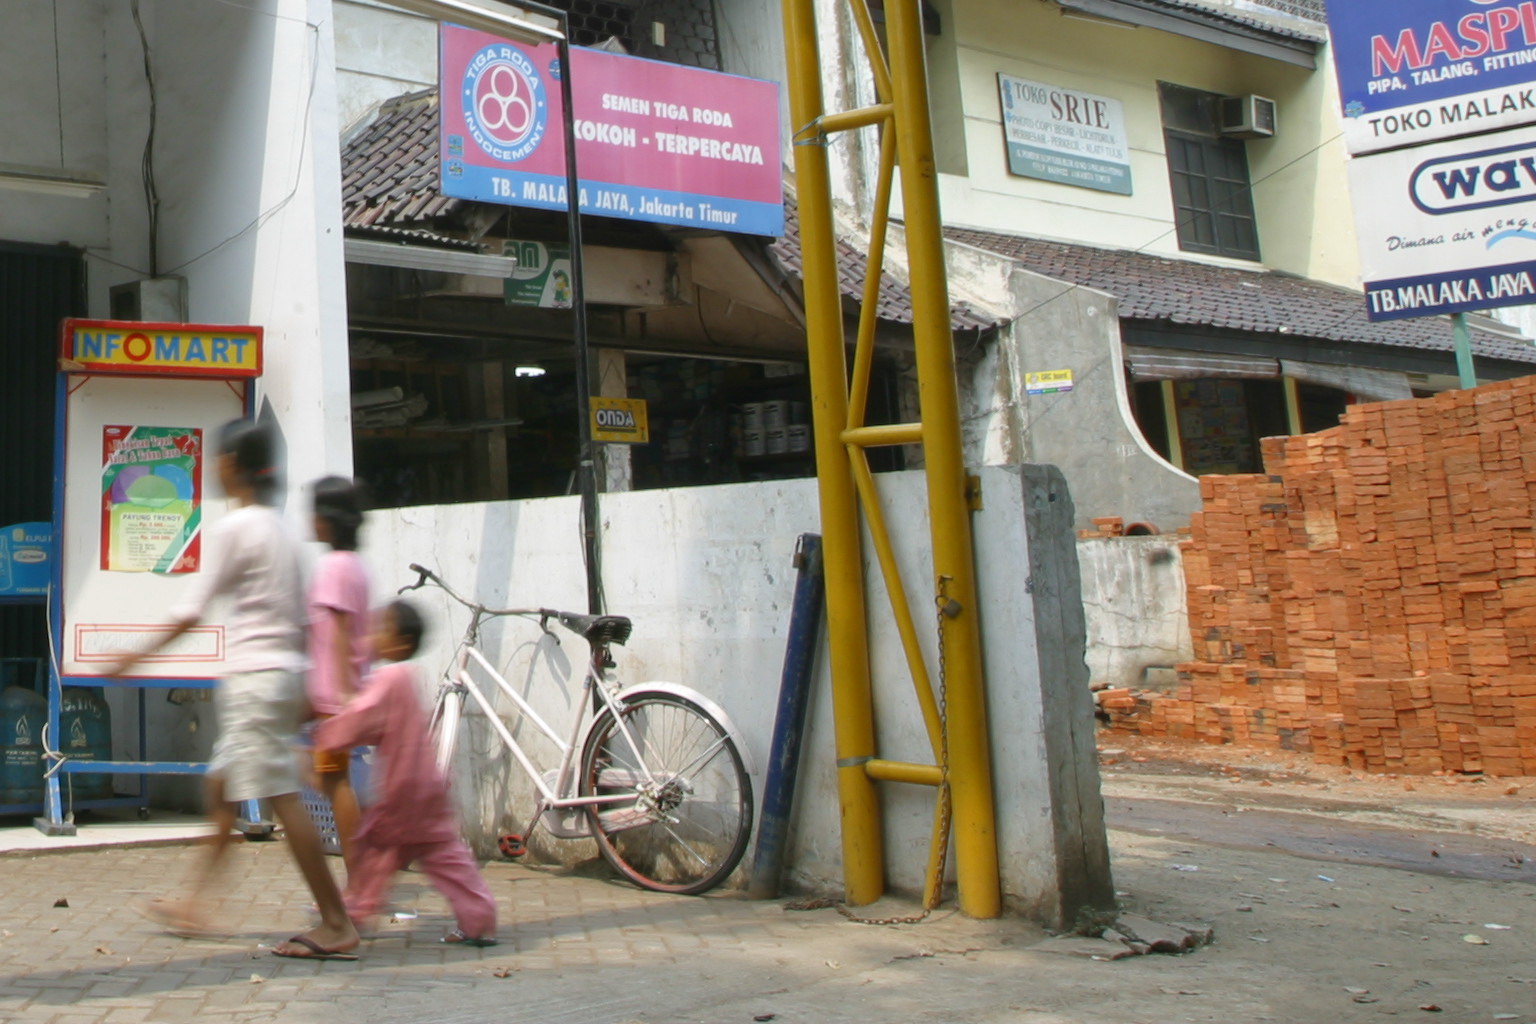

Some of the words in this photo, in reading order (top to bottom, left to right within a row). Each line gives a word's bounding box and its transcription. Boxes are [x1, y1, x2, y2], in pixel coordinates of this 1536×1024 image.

[1370, 1, 1536, 78] MASPI
[466, 48, 498, 79] TIGA
[500, 47, 539, 90] RODA
[1367, 75, 1407, 96] PIPA,
[1410, 61, 1479, 87] TALANG,
[602, 92, 650, 116] SEMEN
[653, 102, 690, 122] TIGA
[693, 107, 733, 128] RODA
[1014, 81, 1047, 106] TOKO
[1049, 90, 1110, 130] SRIE
[1368, 108, 1432, 137] TOKO
[1439, 88, 1536, 125] MALAK
[464, 111, 544, 161] INDOCEMENT
[654, 131, 764, 166] TERPERCAYA
[491, 176, 516, 199] TB.
[522, 180, 589, 208] MALAA
[595, 190, 635, 217] JAYA,
[639, 196, 694, 220] Jakarta
[698, 204, 738, 225] Timur
[1385, 234, 1445, 252] Dimana
[1452, 228, 1476, 243] air
[1486, 270, 1535, 300] JAYA
[73, 332, 250, 364] INFOMART
[595, 408, 636, 428] ONDA
